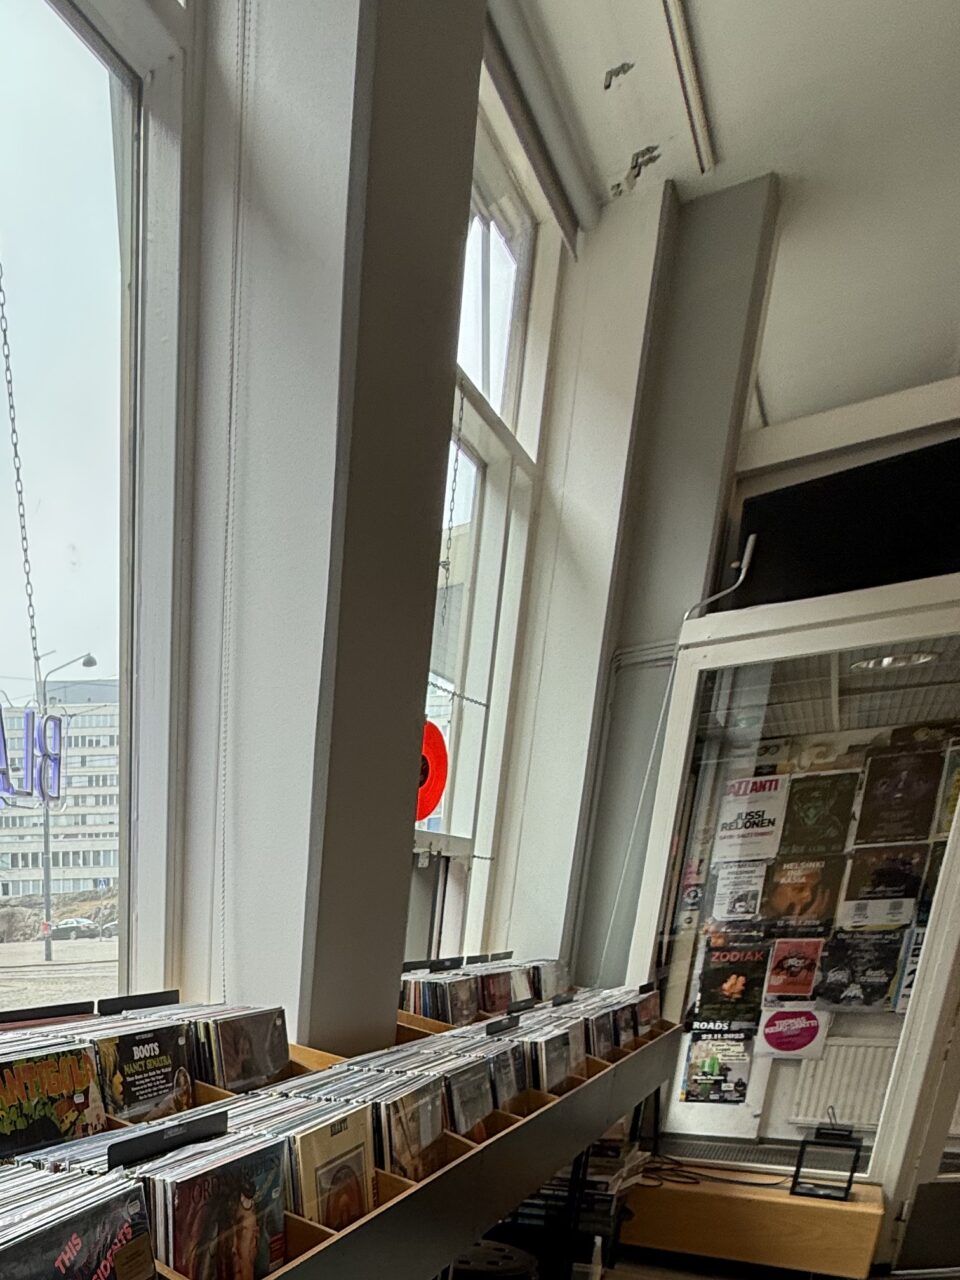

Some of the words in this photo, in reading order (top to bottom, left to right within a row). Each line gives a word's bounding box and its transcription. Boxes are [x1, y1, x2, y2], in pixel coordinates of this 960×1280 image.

[736, 810, 766, 821] JUSSI
[711, 950, 764, 962] ZODIAK
[692, 1021, 730, 1031] ROADS
[132, 1042, 160, 1060] BOOTS
[123, 1060, 146, 1075] NANCY
[146, 1055, 172, 1069] SINATRA
[54, 1232, 83, 1275] THIS
